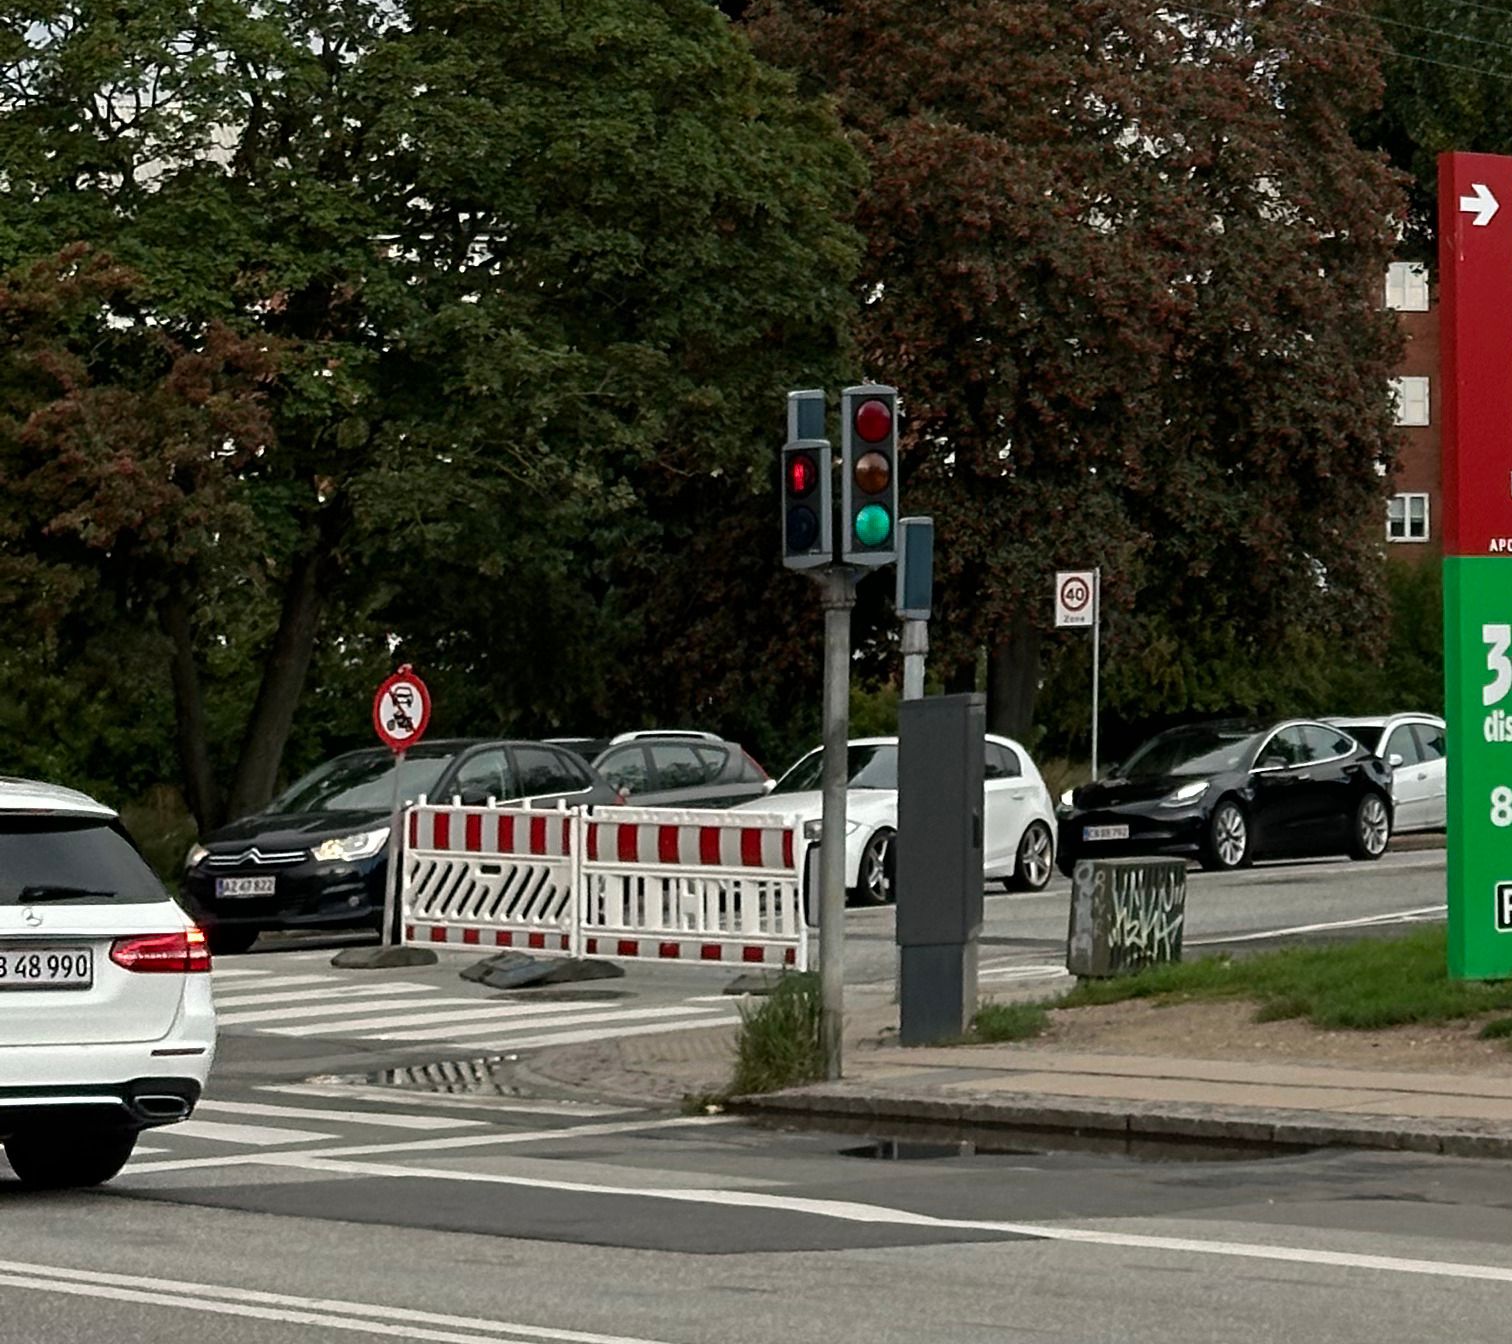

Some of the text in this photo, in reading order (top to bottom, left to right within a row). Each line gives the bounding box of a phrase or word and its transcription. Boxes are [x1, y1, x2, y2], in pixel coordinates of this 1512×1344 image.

[1066, 587, 1084, 601] 40
[14, 955, 41, 978] 48
[47, 955, 88, 978] 990
